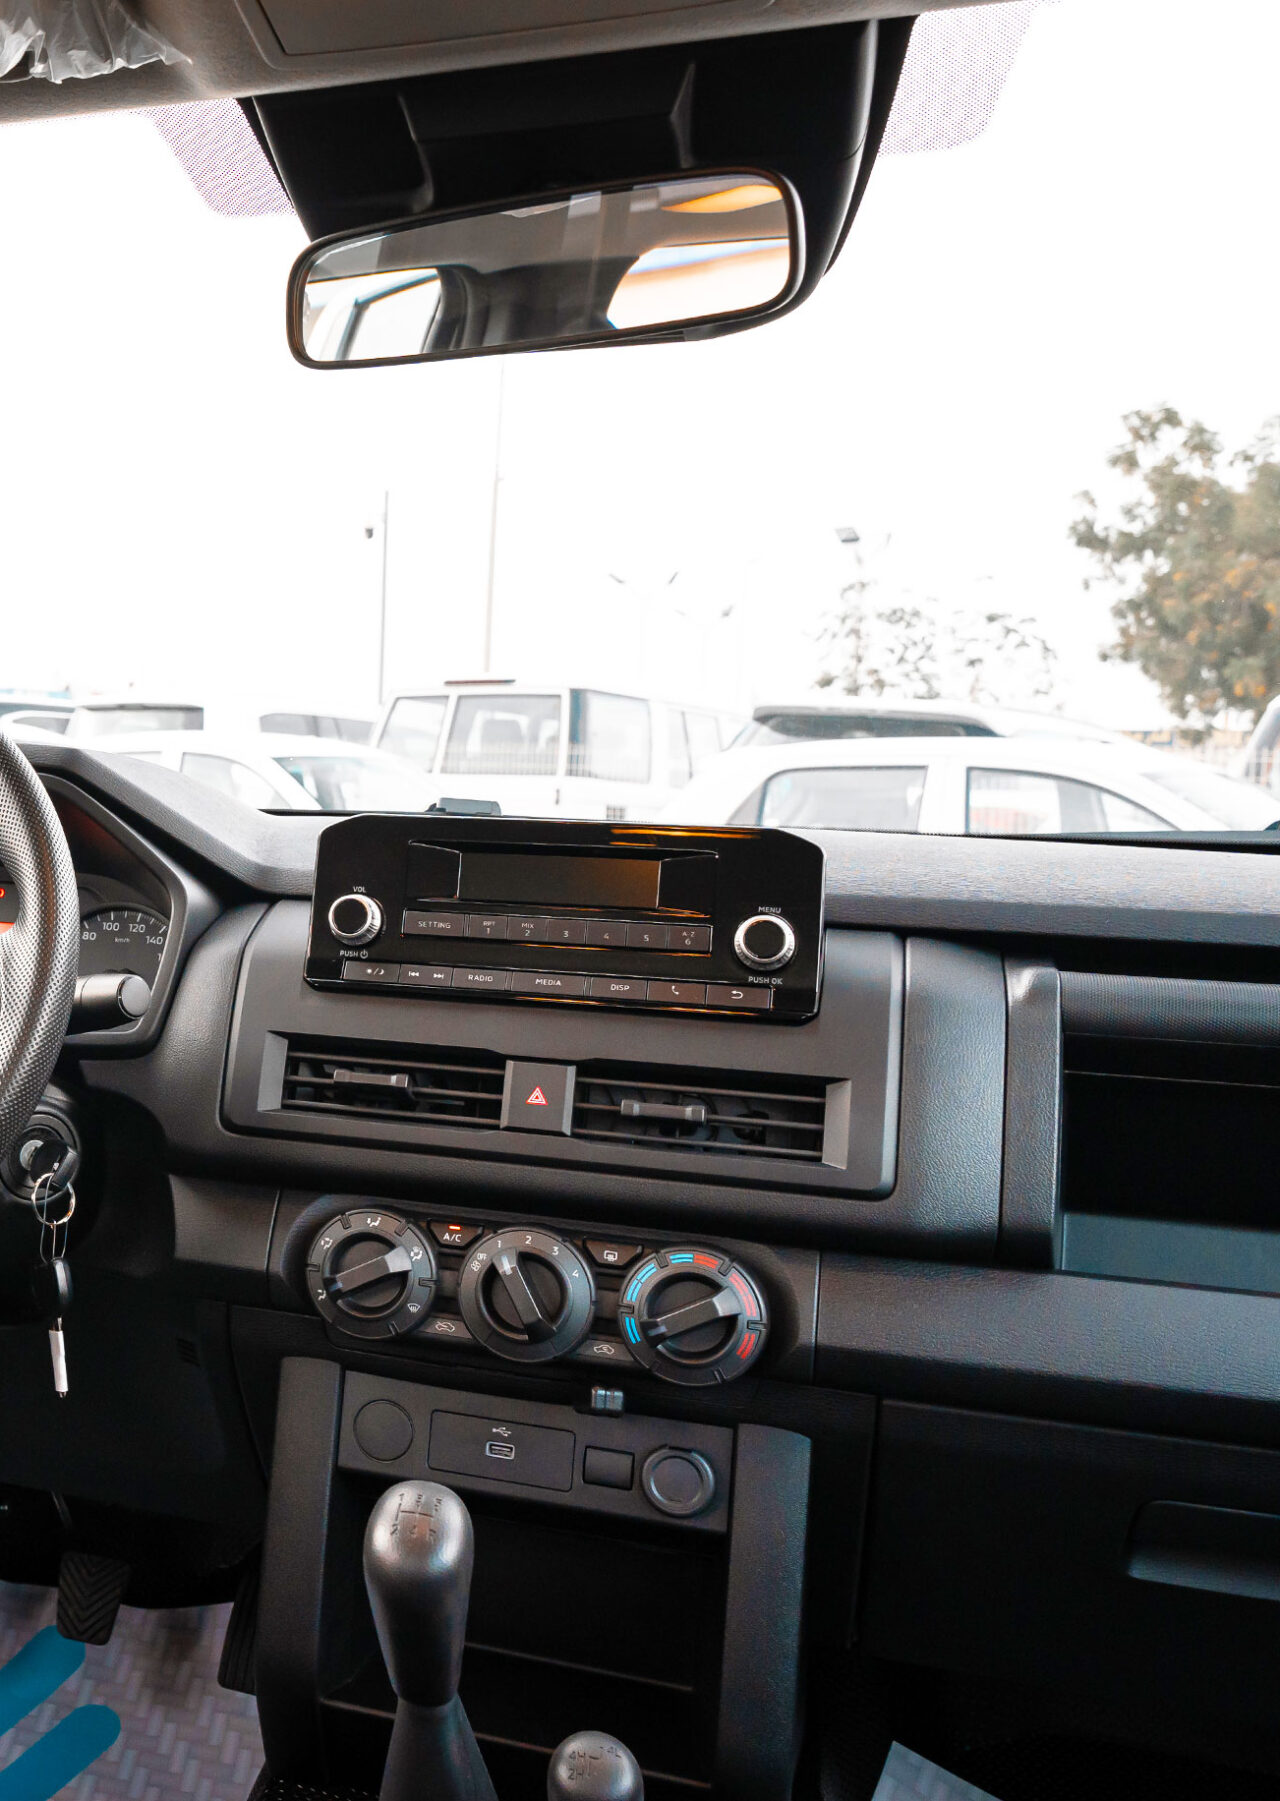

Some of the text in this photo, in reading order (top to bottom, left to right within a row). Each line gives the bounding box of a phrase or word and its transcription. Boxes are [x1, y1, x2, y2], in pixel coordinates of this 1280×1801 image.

[758, 906, 782, 914] MENU
[102, 922, 120, 931] 100
[129, 924, 146, 932] 120
[418, 920, 451, 929] SETTING
[82, 932, 96, 940] 80
[146, 936, 163, 944] 140
[468, 974, 493, 982] RADIO
[536, 978, 562, 986] MEDIA
[748, 976, 770, 984] PUSH
[443, 1233, 462, 1242] A/C
[526, 1236, 532, 1244] 2
[496, 1240, 502, 1248] 1
[552, 1246, 559, 1256] 3
[572, 1269, 580, 1278] 4
